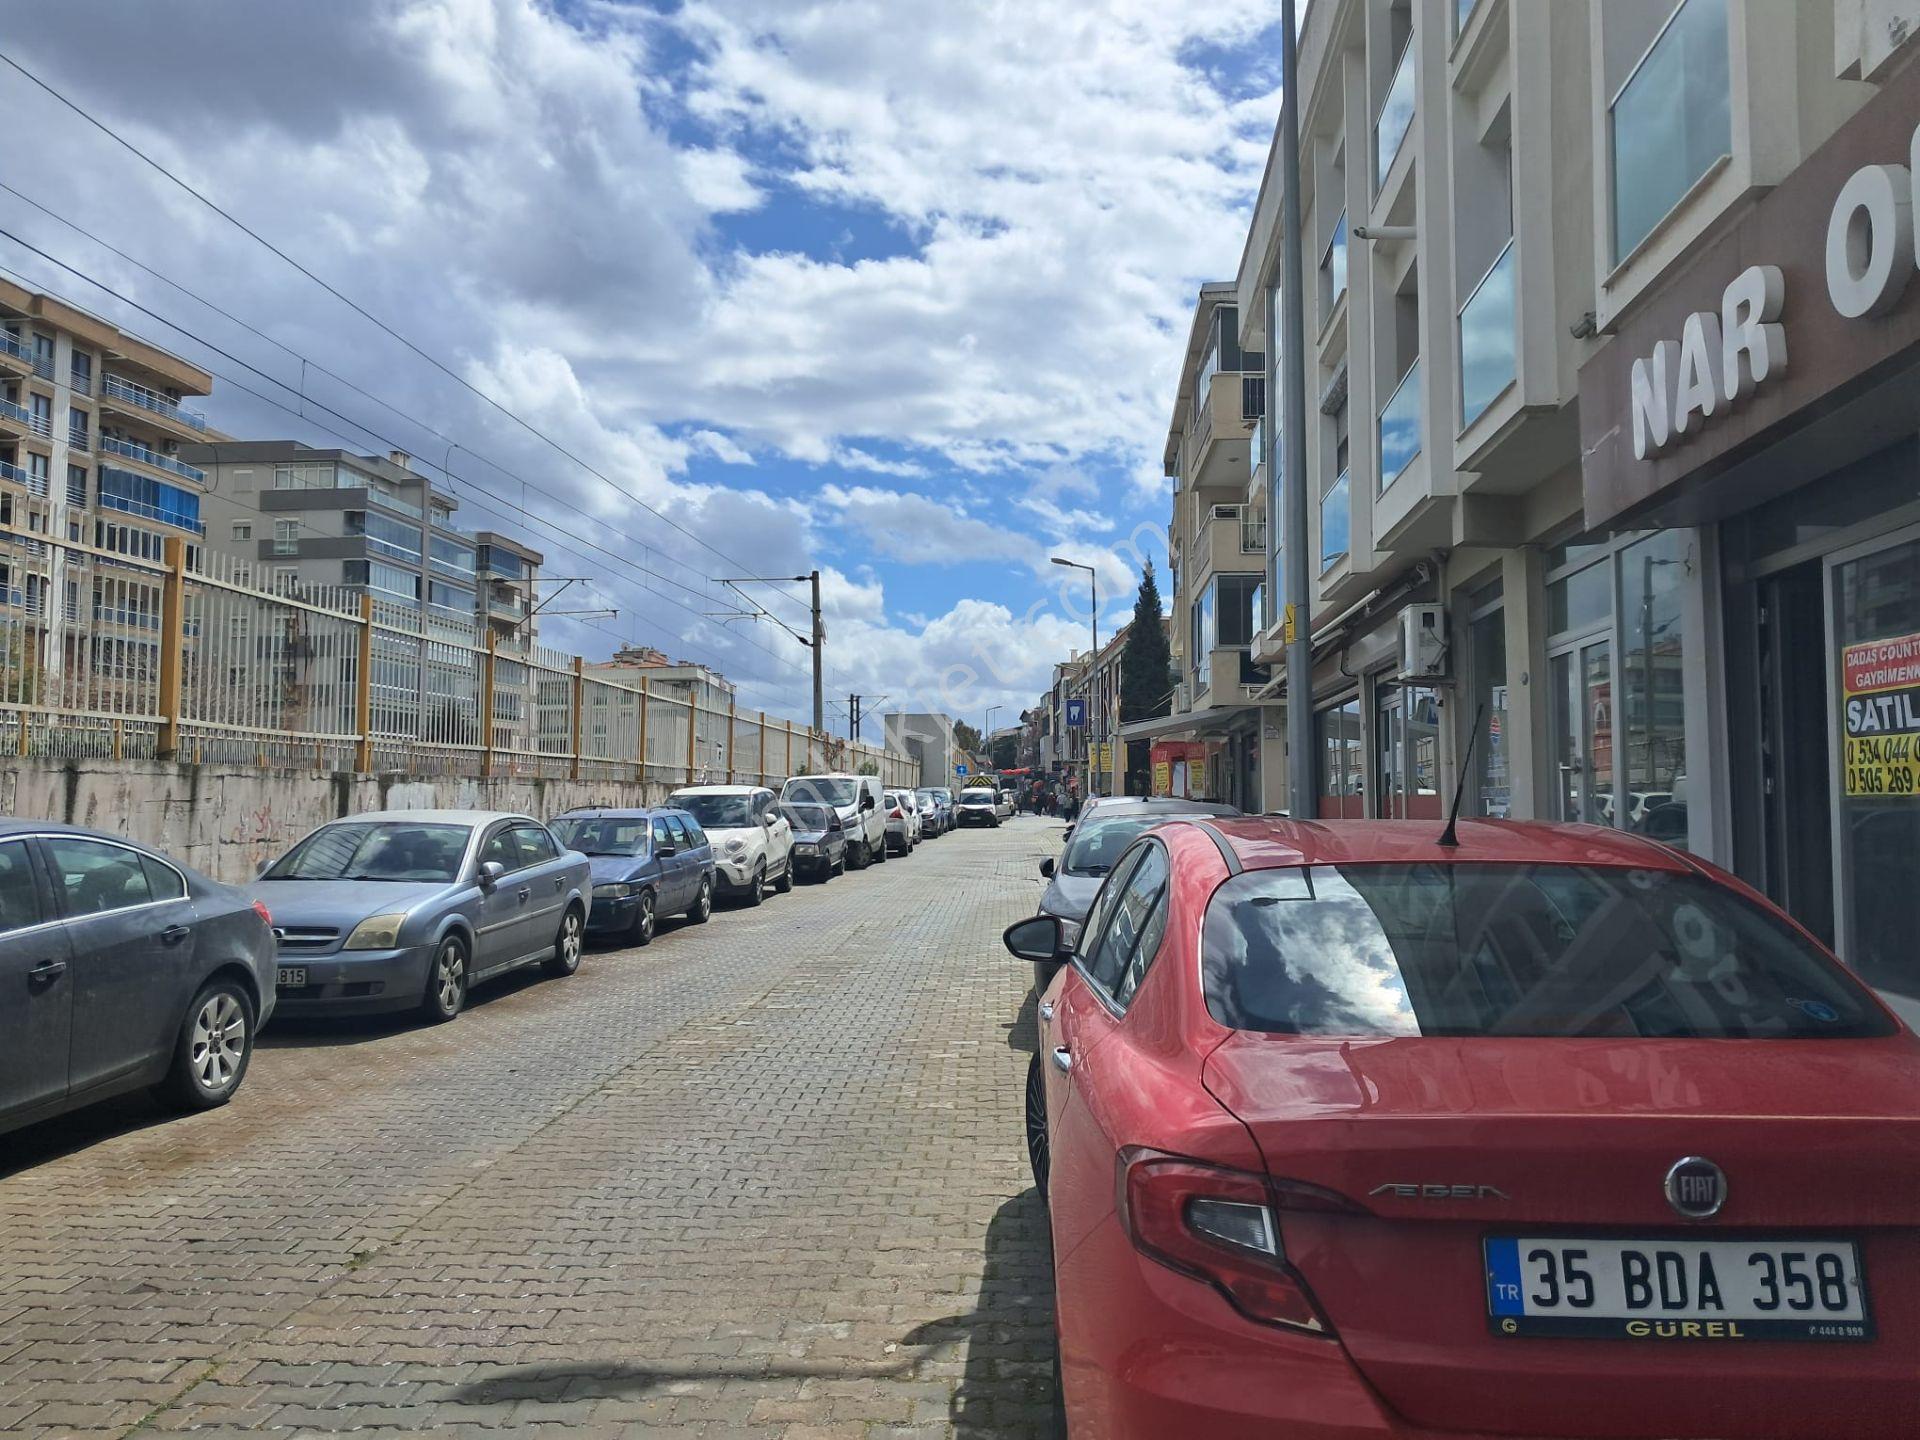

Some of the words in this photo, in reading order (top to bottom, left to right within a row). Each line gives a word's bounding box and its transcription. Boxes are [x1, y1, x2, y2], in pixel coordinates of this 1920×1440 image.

[1631, 264, 1786, 461] NAR
[1826, 123, 1920, 318] O
[1847, 648, 1877, 667] DADAŞ
[1879, 639, 1920, 661] COUNT
[1847, 693, 1920, 733] SATIL
[1848, 740, 1854, 765] 0
[1858, 738, 1881, 764] 534
[1884, 736, 1910, 763] 044
[1849, 768, 1856, 793] 0
[1858, 767, 1882, 793] 505
[1887, 766, 1913, 793] 269
[1680, 1175, 1715, 1202] FIAT
[1496, 1283, 1519, 1300] TR
[1527, 1248, 1595, 1308] 35
[1620, 1250, 1725, 1311] BDA
[1747, 1252, 1849, 1312] 358
[1625, 1320, 1745, 1337] GÜREL
